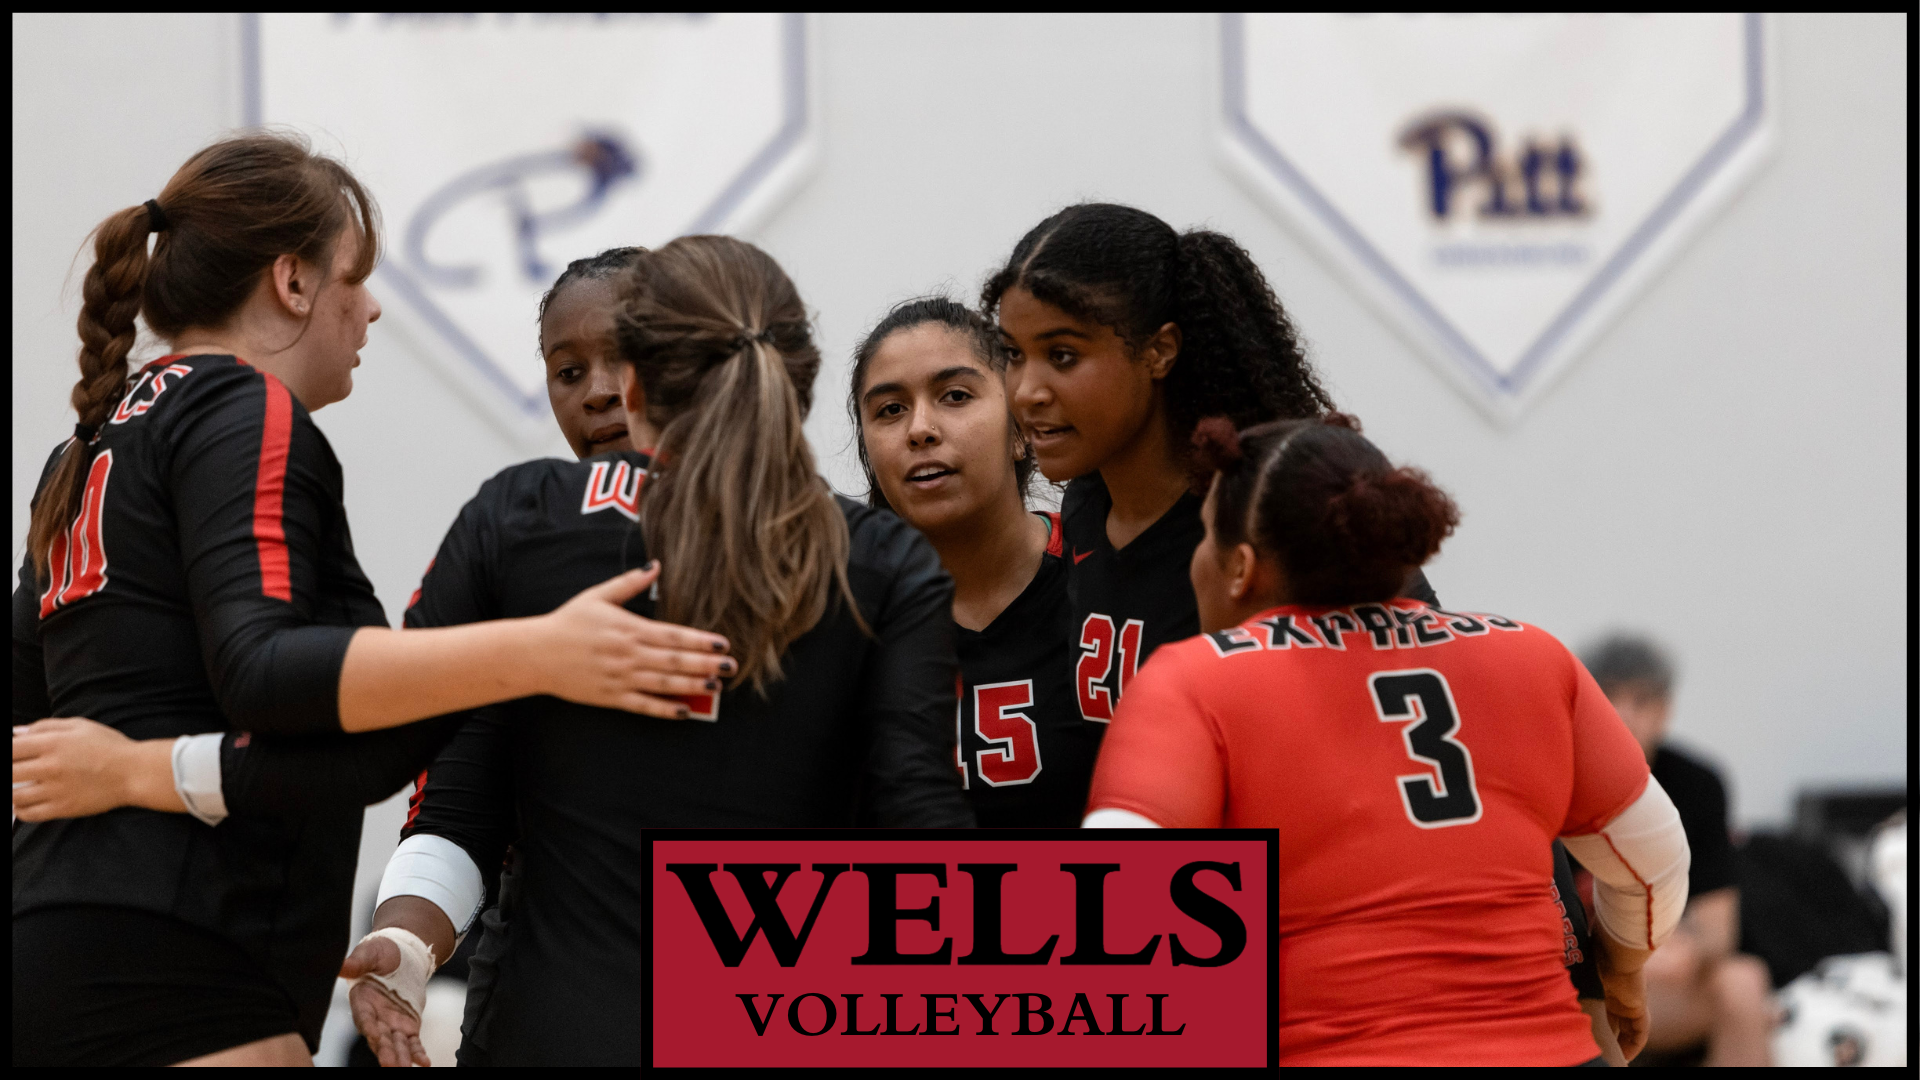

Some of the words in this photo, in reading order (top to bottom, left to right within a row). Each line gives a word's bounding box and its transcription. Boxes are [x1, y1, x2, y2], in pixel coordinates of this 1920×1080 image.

[1398, 108, 1597, 226] Pitt
[1076, 612, 1145, 724] 21
[955, 672, 1043, 788] 5
[1367, 668, 1483, 829] 3
